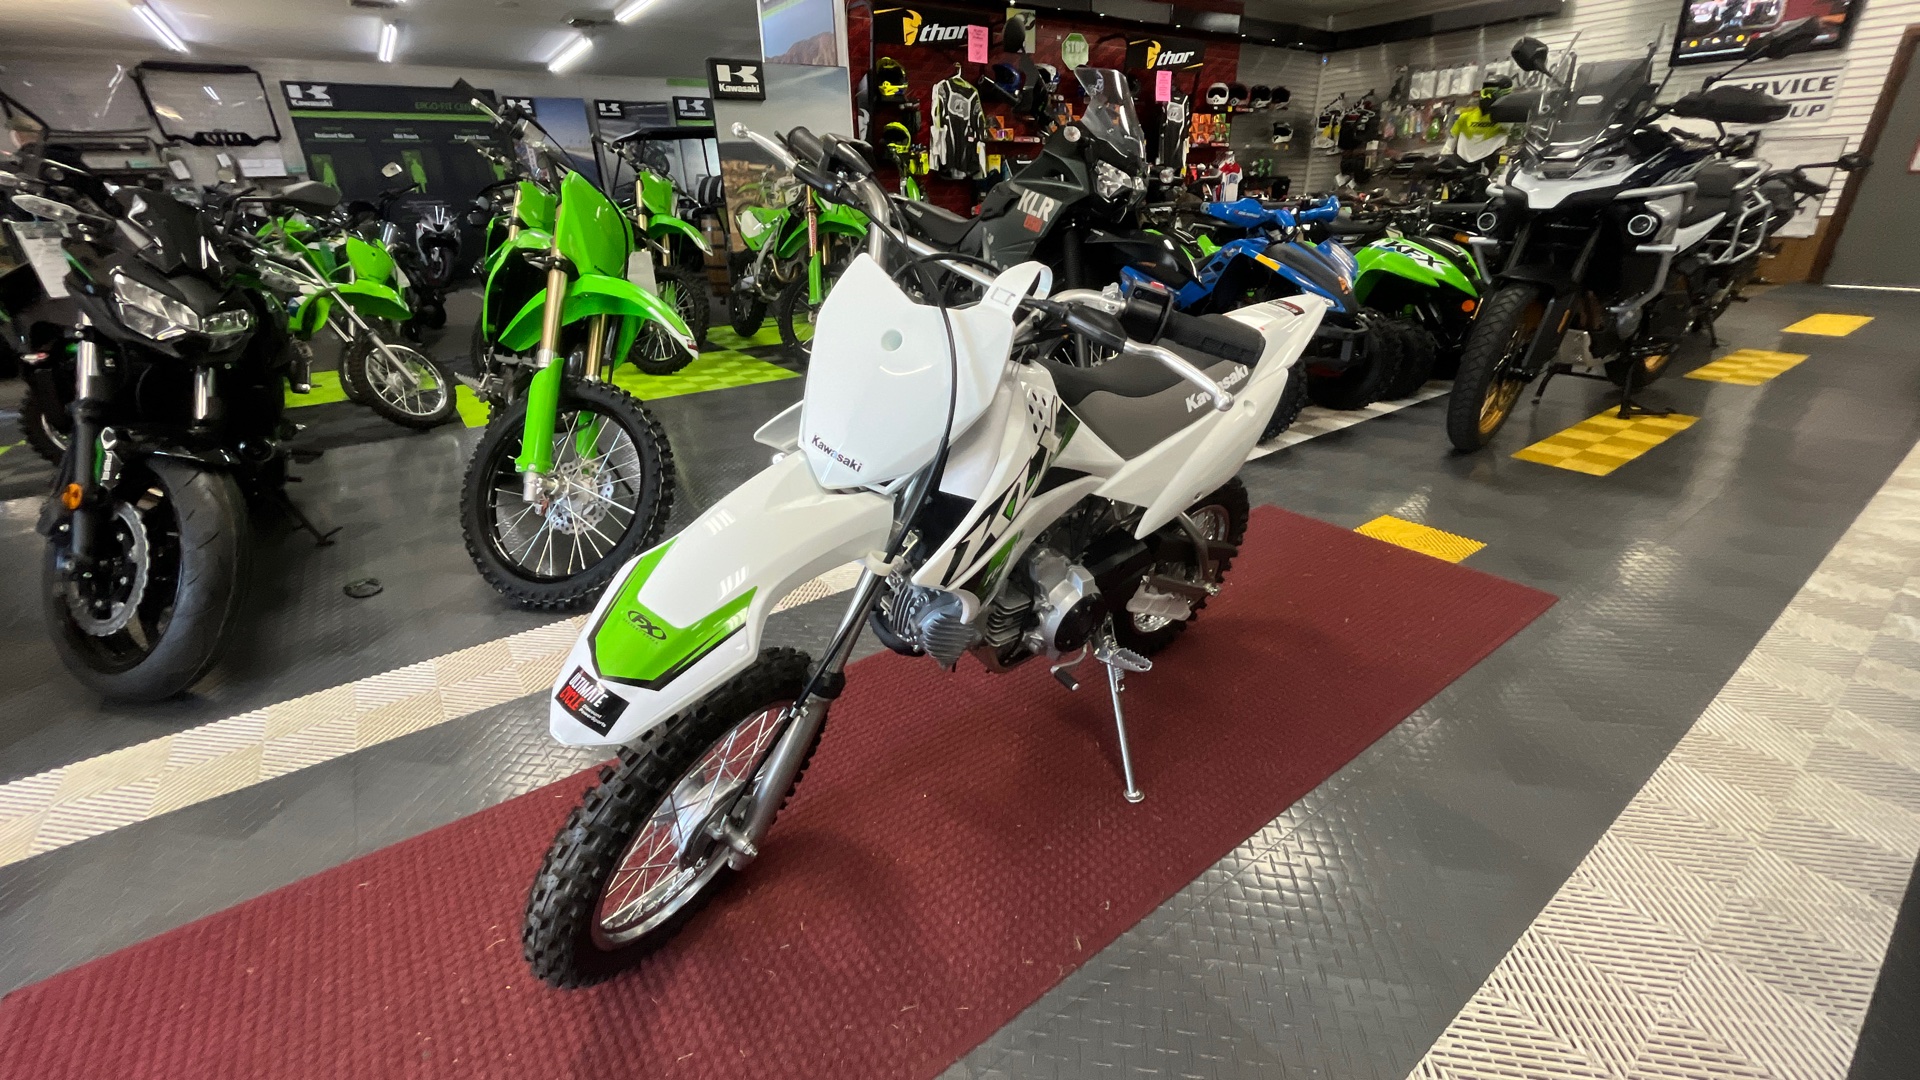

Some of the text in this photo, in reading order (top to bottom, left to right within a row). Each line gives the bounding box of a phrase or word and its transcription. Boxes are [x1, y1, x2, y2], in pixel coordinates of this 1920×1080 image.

[919, 23, 968, 42] thor
[1065, 40, 1086, 53] STOP
[1157, 50, 1195, 66] thor
[719, 83, 760, 93] Kawasaki
[1017, 188, 1055, 222] KLR
[811, 434, 863, 473] Kawasaki
[559, 685, 585, 711] CYCLE
[568, 671, 609, 708] ULTIMATE
